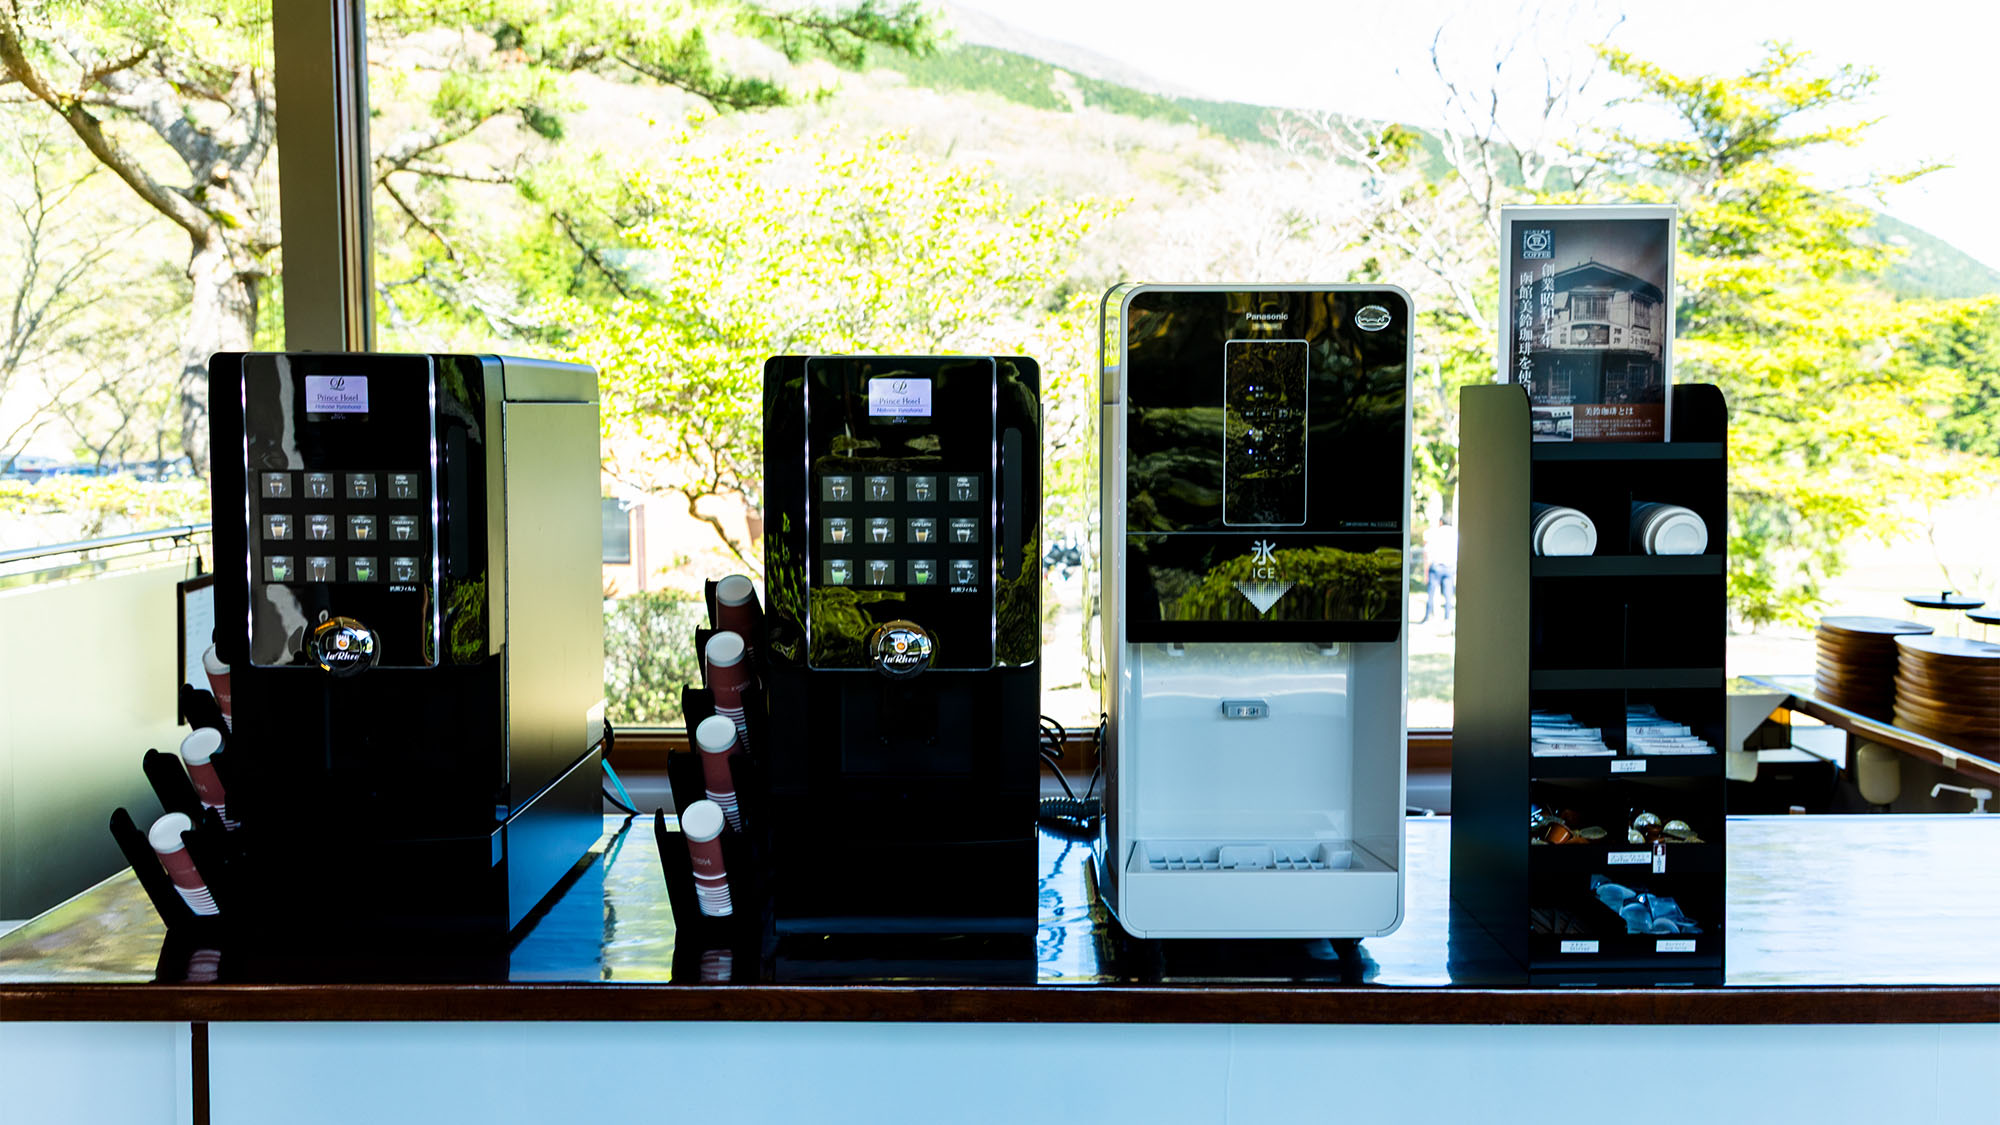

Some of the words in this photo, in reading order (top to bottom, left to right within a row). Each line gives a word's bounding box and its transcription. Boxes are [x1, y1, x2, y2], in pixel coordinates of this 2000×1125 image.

[1246, 312, 1288, 320] Panasonic
[317, 394, 338, 402] Prince
[340, 393, 359, 402] Hotel
[1585, 406, 1634, 416] 美鈴珈琲とは
[1251, 539, 1276, 566] 氷
[1252, 568, 1275, 579] ICE
[1237, 706, 1259, 716] PUSH
